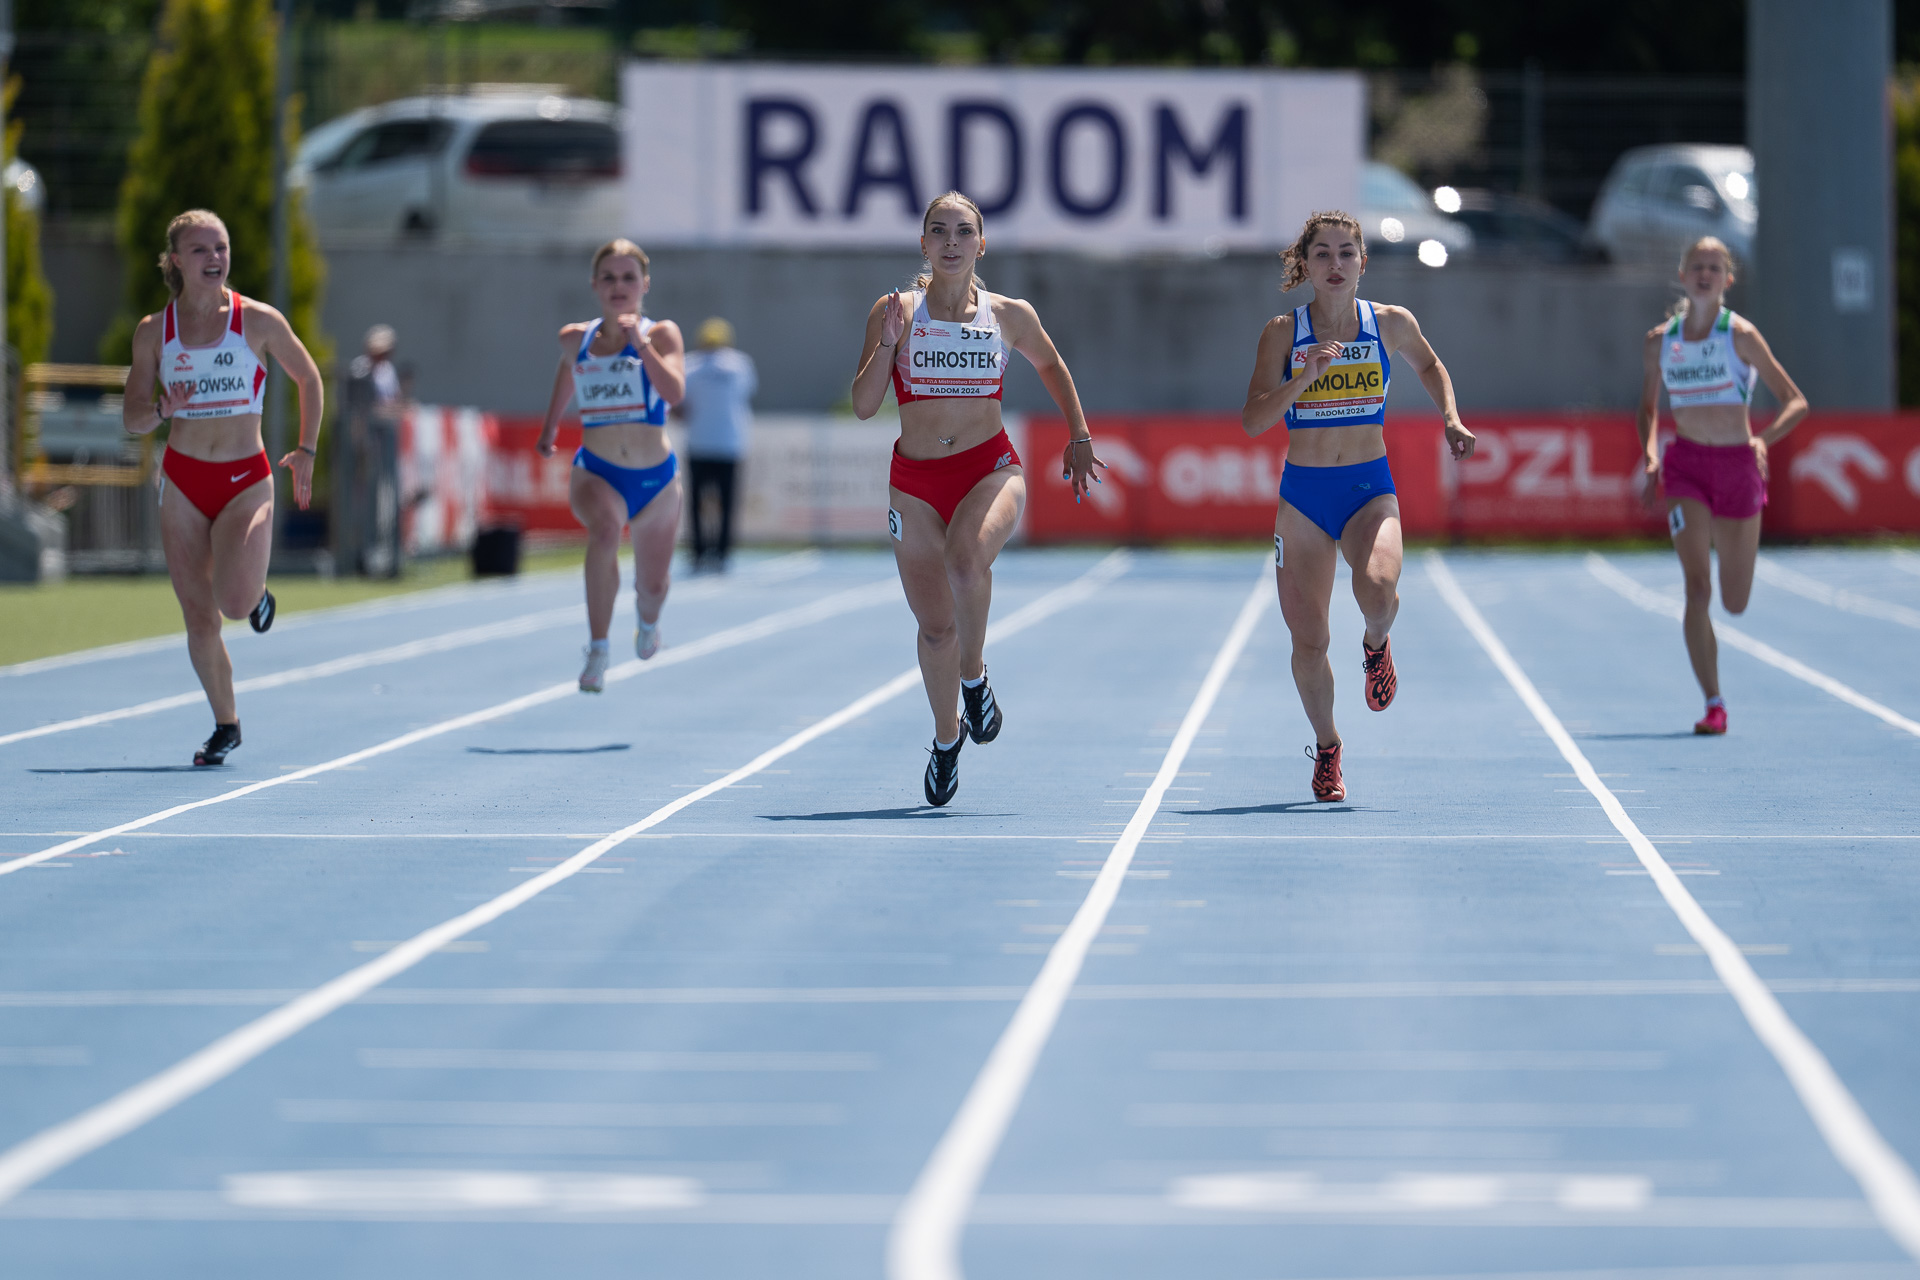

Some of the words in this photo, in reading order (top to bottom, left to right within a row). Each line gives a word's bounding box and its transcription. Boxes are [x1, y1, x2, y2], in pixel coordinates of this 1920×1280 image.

[742, 97, 1249, 221] RADOM
[214, 352, 234, 366] 40
[913, 350, 998, 369] CHROSTEK
[1341, 345, 1371, 361] 487
[1303, 371, 1379, 392] IMOLĄG
[1315, 409, 1344, 417] RADOM
[1345, 407, 1366, 415] 2024
[1159, 444, 1282, 505] ORL
